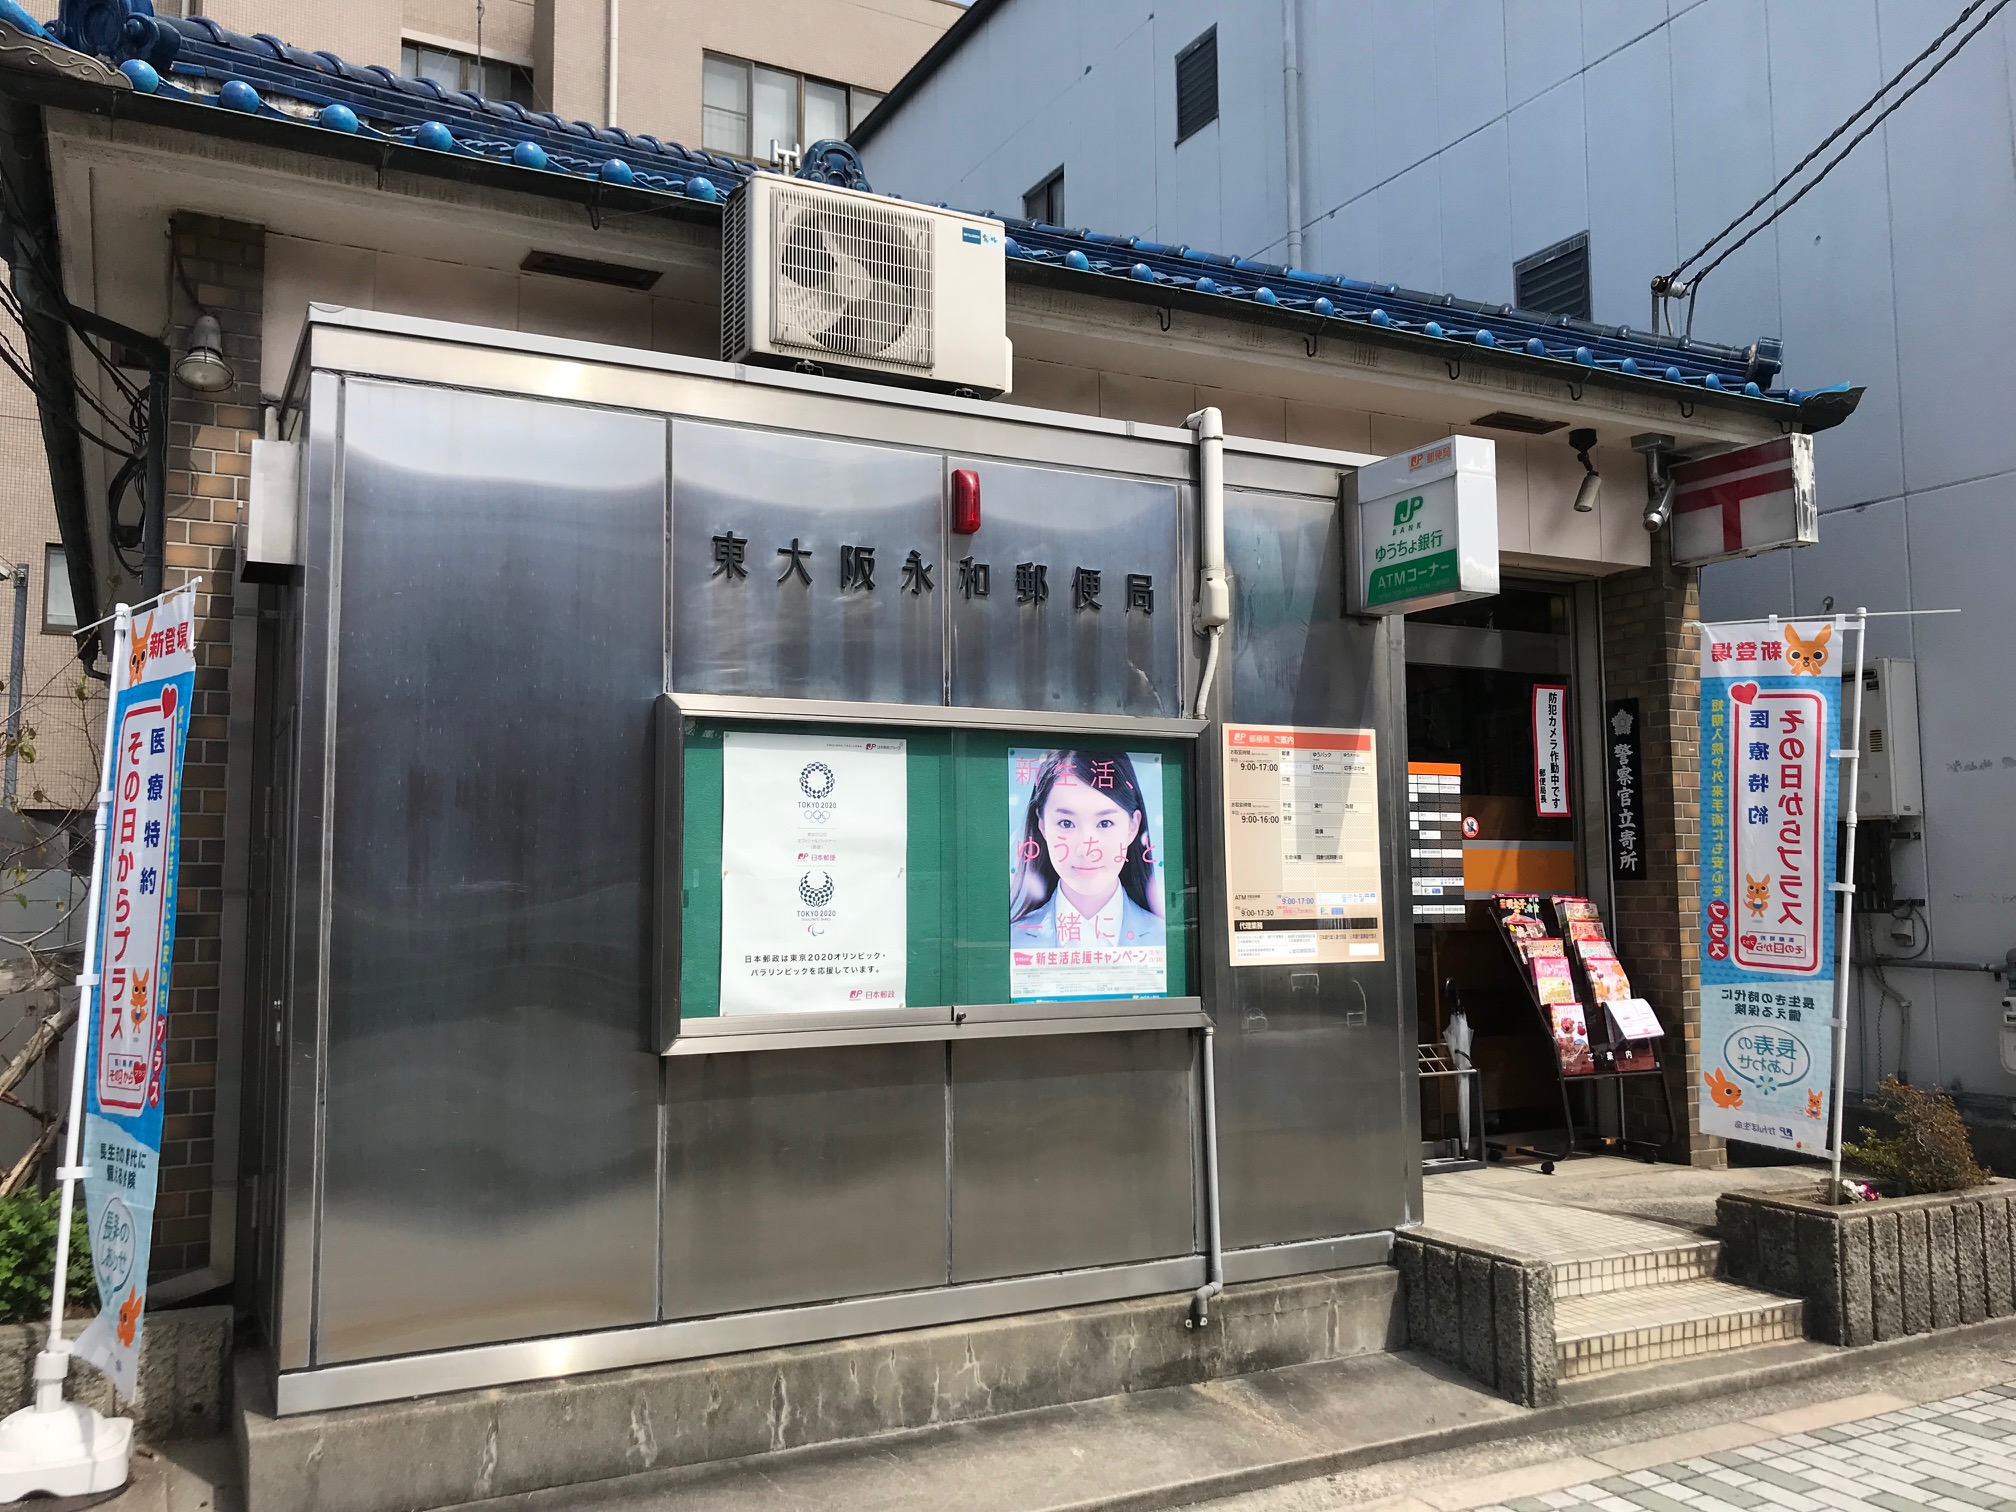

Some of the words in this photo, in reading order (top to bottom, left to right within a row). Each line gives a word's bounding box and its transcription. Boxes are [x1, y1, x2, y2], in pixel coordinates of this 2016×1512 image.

[1427, 447, 1451, 463] 郵便局
[1394, 496, 1424, 526] JP
[1392, 522, 1422, 536] BANK
[1375, 529, 1443, 562] ゆうちょ銀行
[712, 531, 1155, 615] 東大阪永和郵便局
[1377, 561, 1450, 589] ATMコーナー
[149, 621, 189, 660] 新登場
[1274, 736, 1294, 745] ご案内
[1548, 692, 1560, 809] 防犯カメラ作動中です
[1241, 763, 1278, 772] 9:00-17:00
[1539, 769, 1547, 803] 郵便局長
[140, 727, 165, 895] 医療特約
[1241, 816, 1280, 824] 9:00-16:00
[1614, 743, 1638, 872] 警察官立寄所
[811, 854, 836, 862] 日本郵便
[1017, 836, 1157, 863] ゆうちょと
[111, 732, 143, 1040] その日からプラス
[1241, 909, 1275, 917] 9:00-17:30
[1017, 912, 1135, 942] 一緒に。
[1036, 950, 1147, 965] 新生活応援キャンペーン
[751, 966, 880, 977] パラリンピックを応援しています。
[866, 990, 895, 999] 日本郵政
